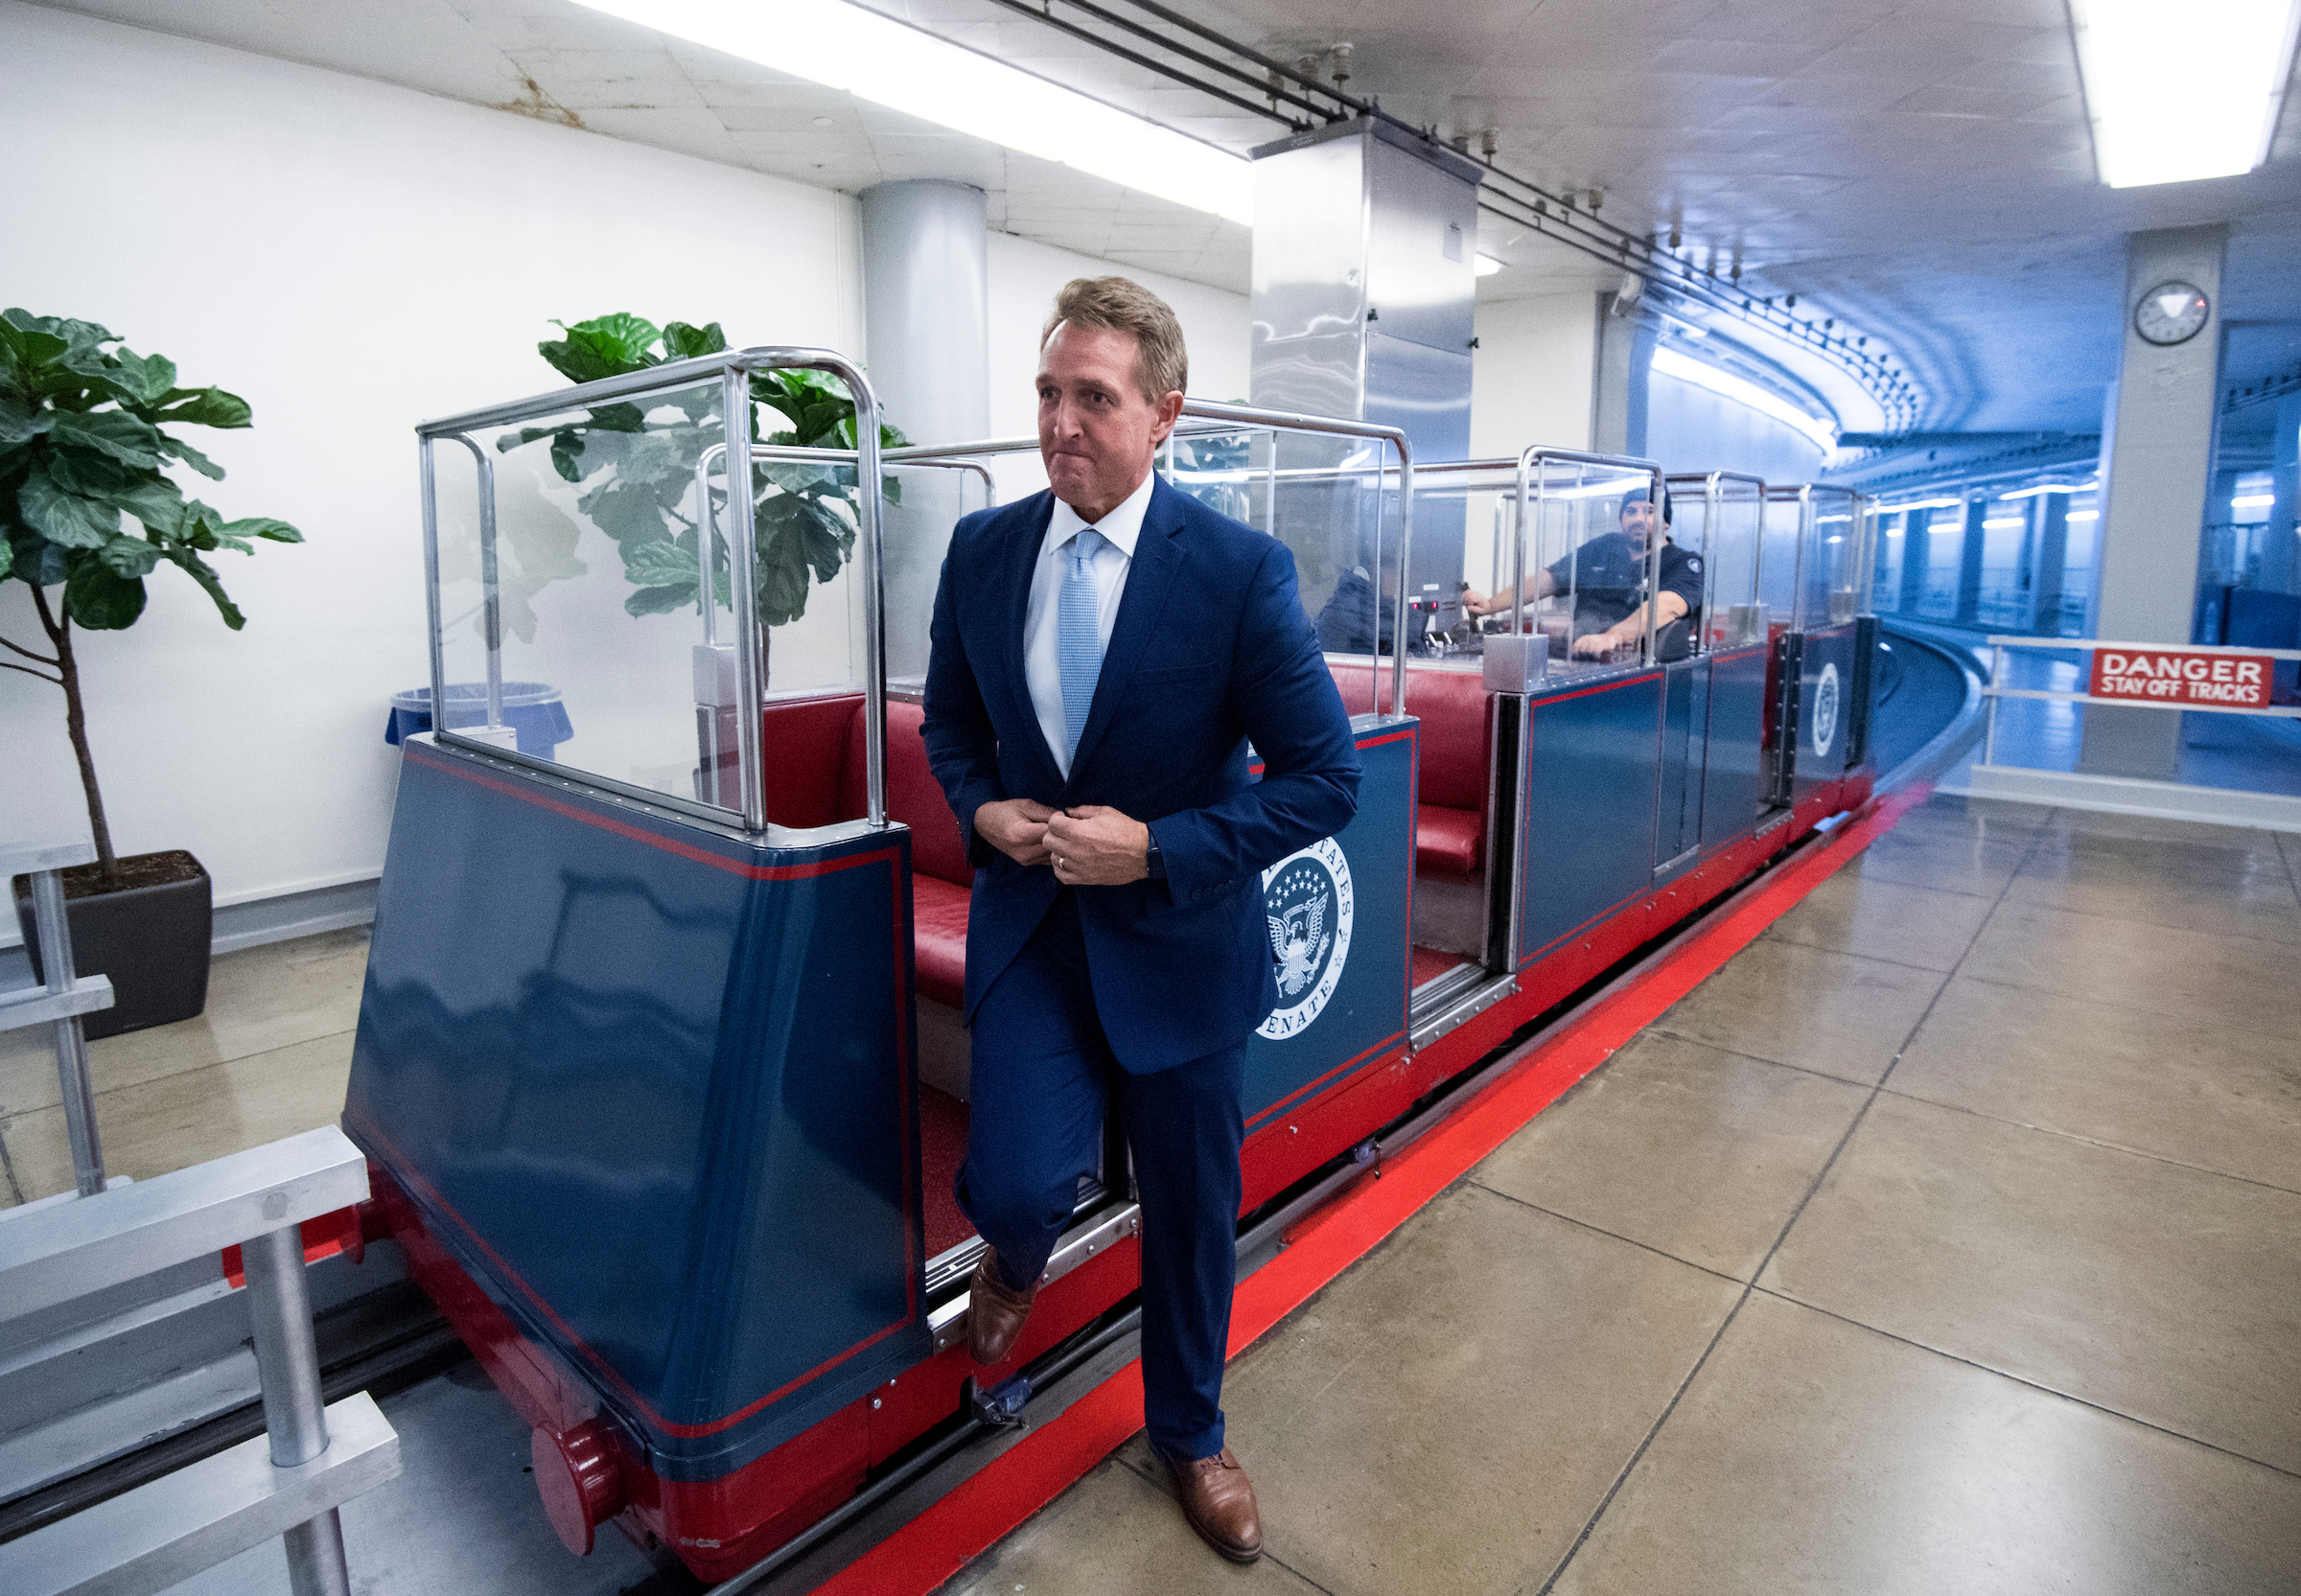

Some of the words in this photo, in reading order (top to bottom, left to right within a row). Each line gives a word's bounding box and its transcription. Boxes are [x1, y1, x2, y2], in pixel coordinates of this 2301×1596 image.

[2102, 654, 2263, 684] DANGER
[2100, 676, 2147, 694] STAY
[2147, 680, 2183, 697] OFF
[2187, 682, 2261, 703] TRACKS
[1266, 980, 1332, 1034] ENATE
